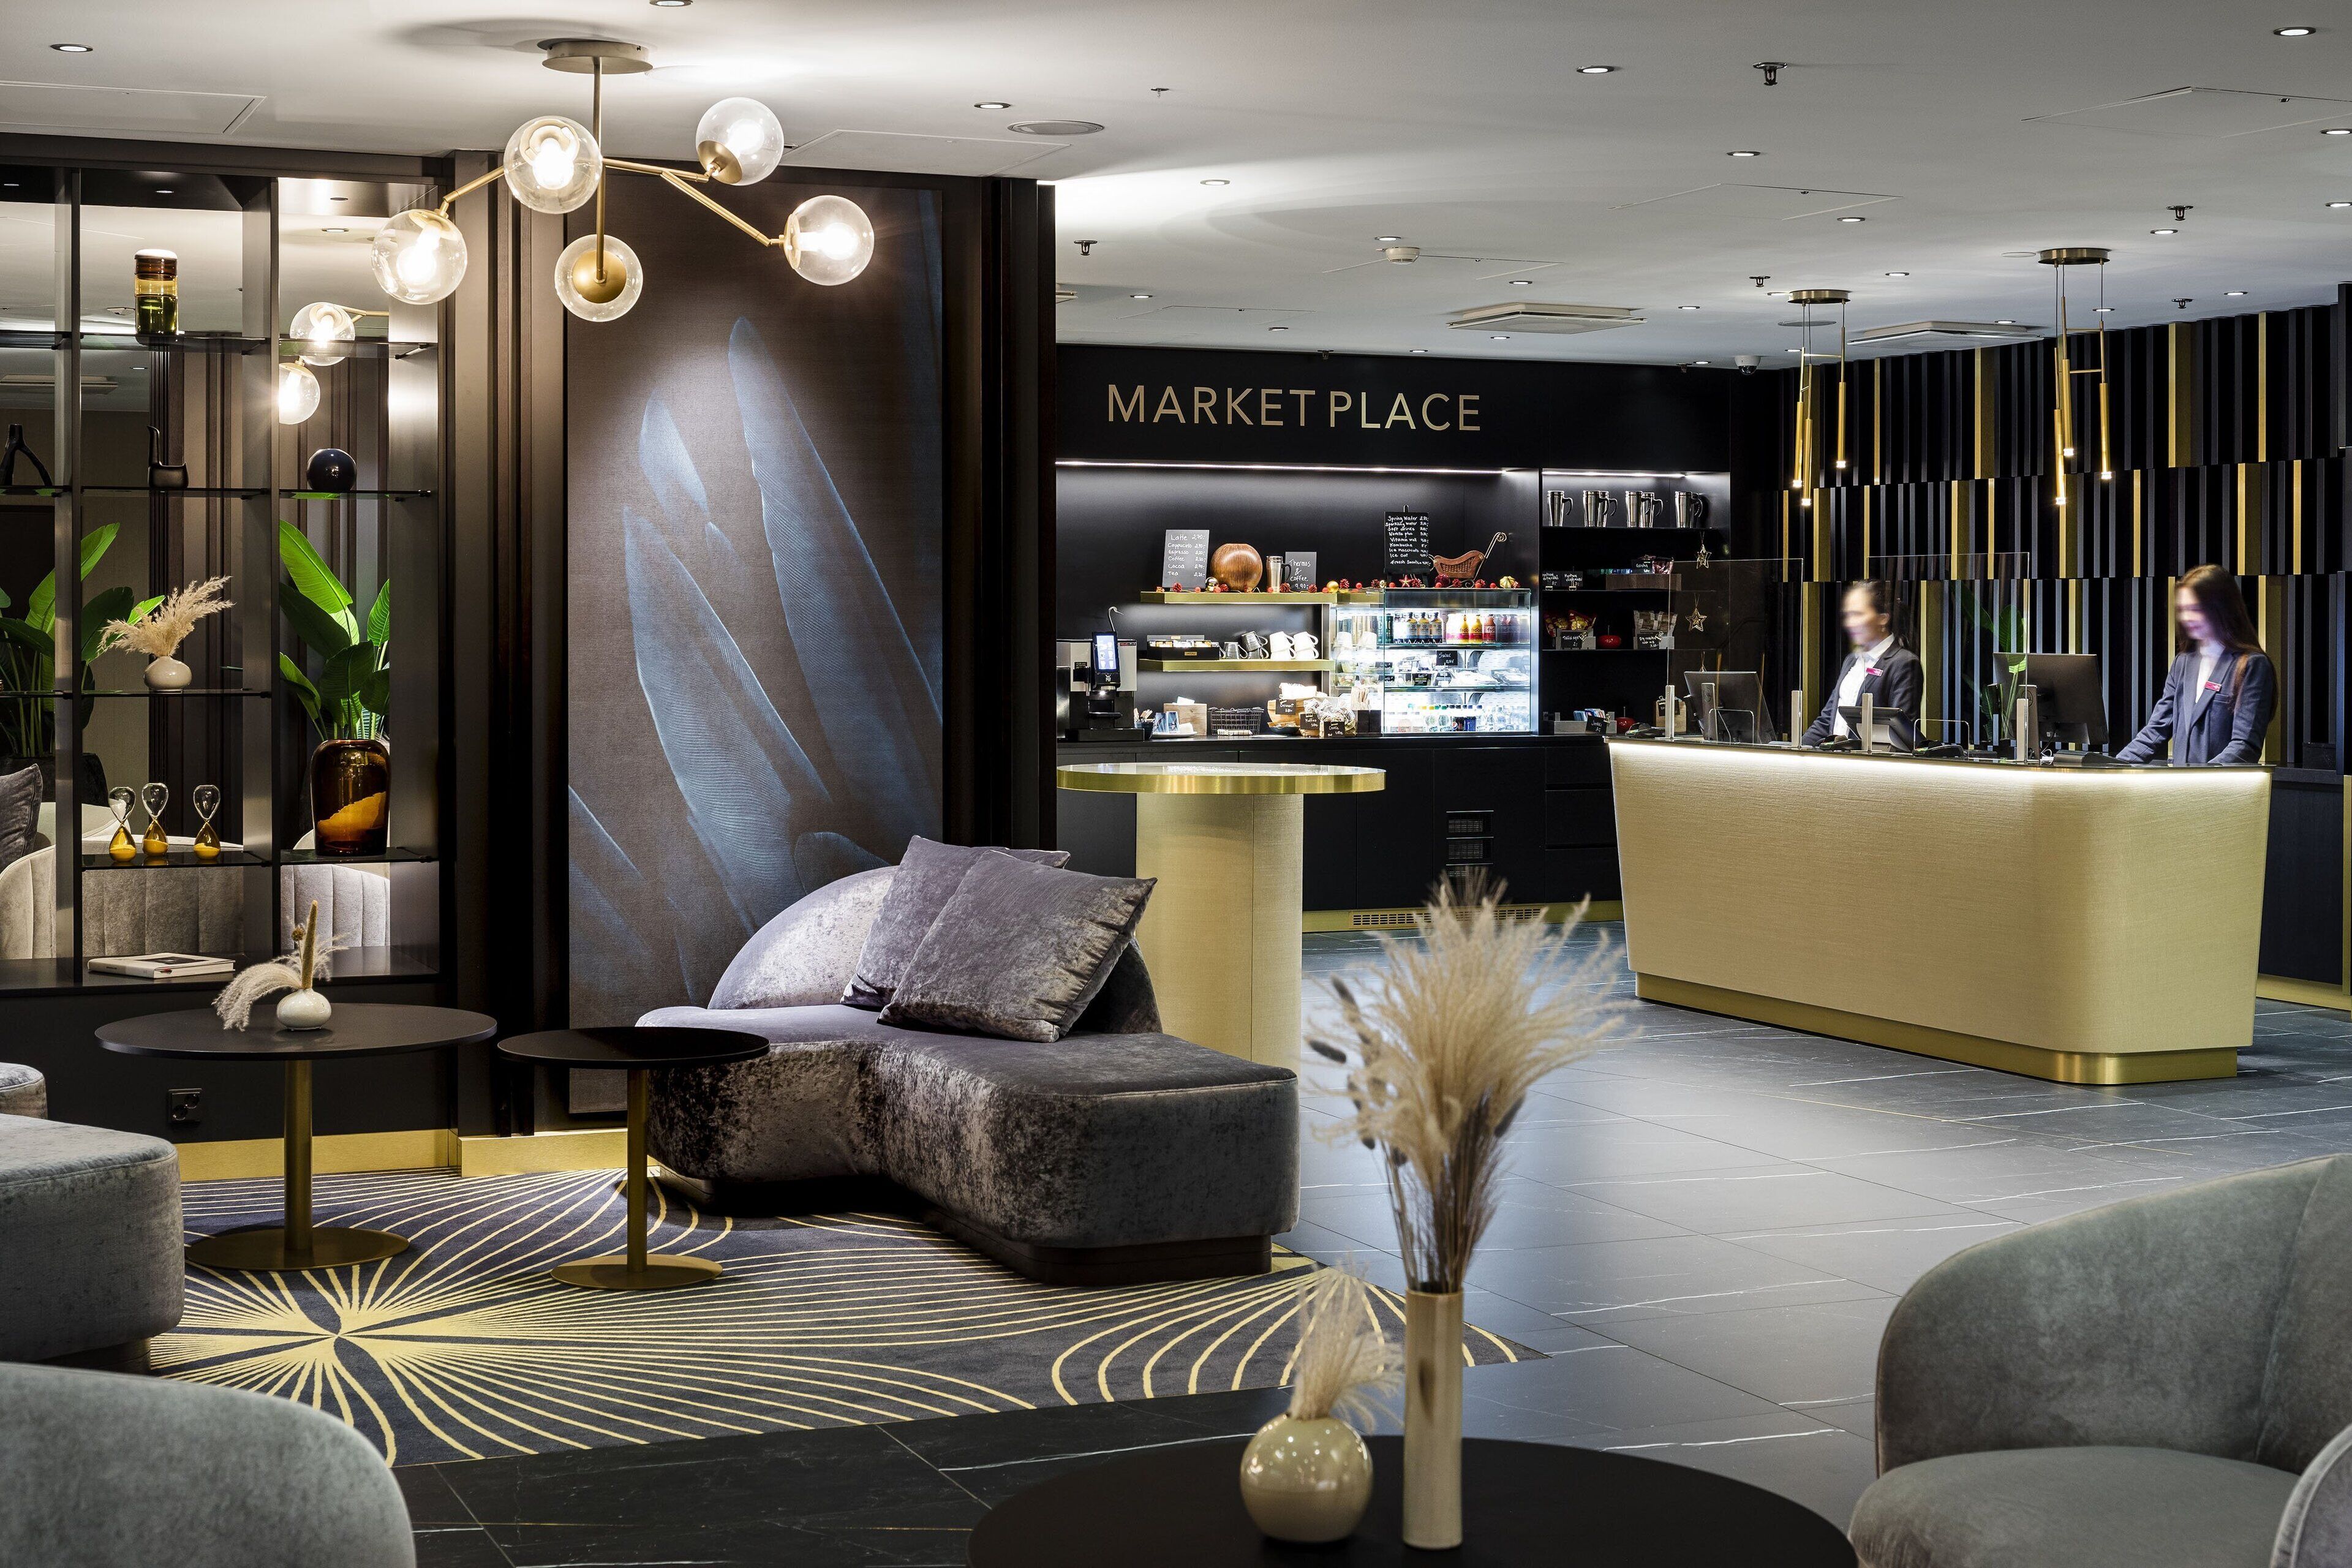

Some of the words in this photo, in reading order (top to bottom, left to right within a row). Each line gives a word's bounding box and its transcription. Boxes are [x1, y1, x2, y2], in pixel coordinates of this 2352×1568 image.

[1108, 383, 1316, 426] MARKET
[1330, 390, 1481, 432] PLACE
[1289, 559, 1311, 567] Thermos
